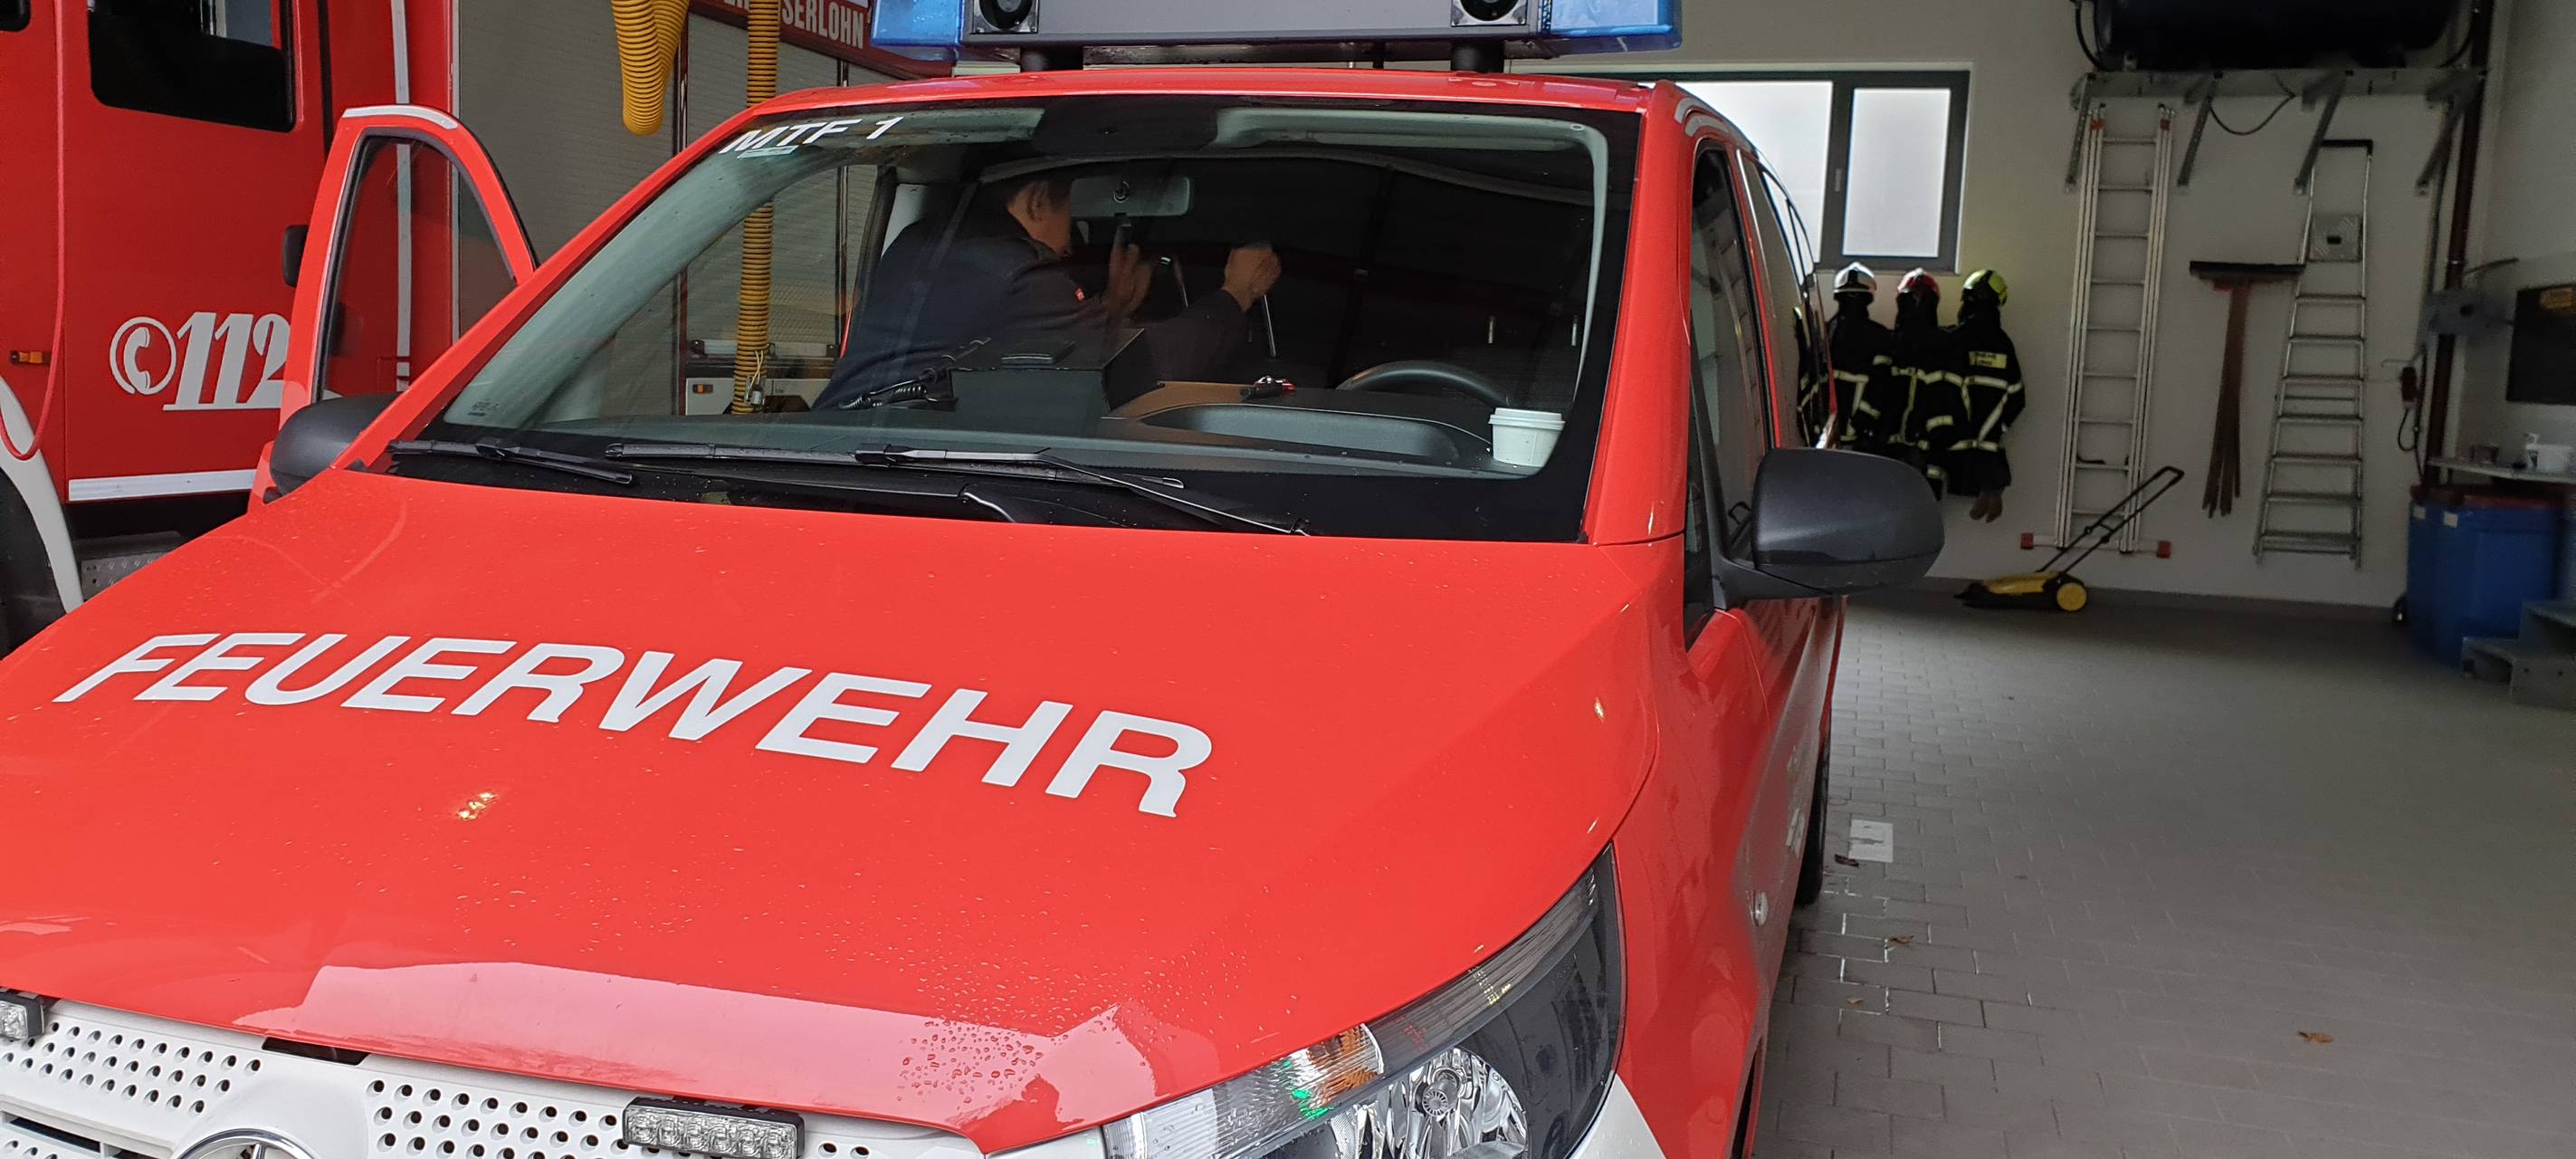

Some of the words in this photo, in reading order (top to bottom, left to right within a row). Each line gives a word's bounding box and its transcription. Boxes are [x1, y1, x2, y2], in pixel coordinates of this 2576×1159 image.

[778, 0, 864, 49] SERLOHN
[719, 119, 863, 155] MTF
[865, 116, 904, 139] 1
[162, 311, 291, 411] 112
[51, 632, 1213, 818] FEUERWEHR
